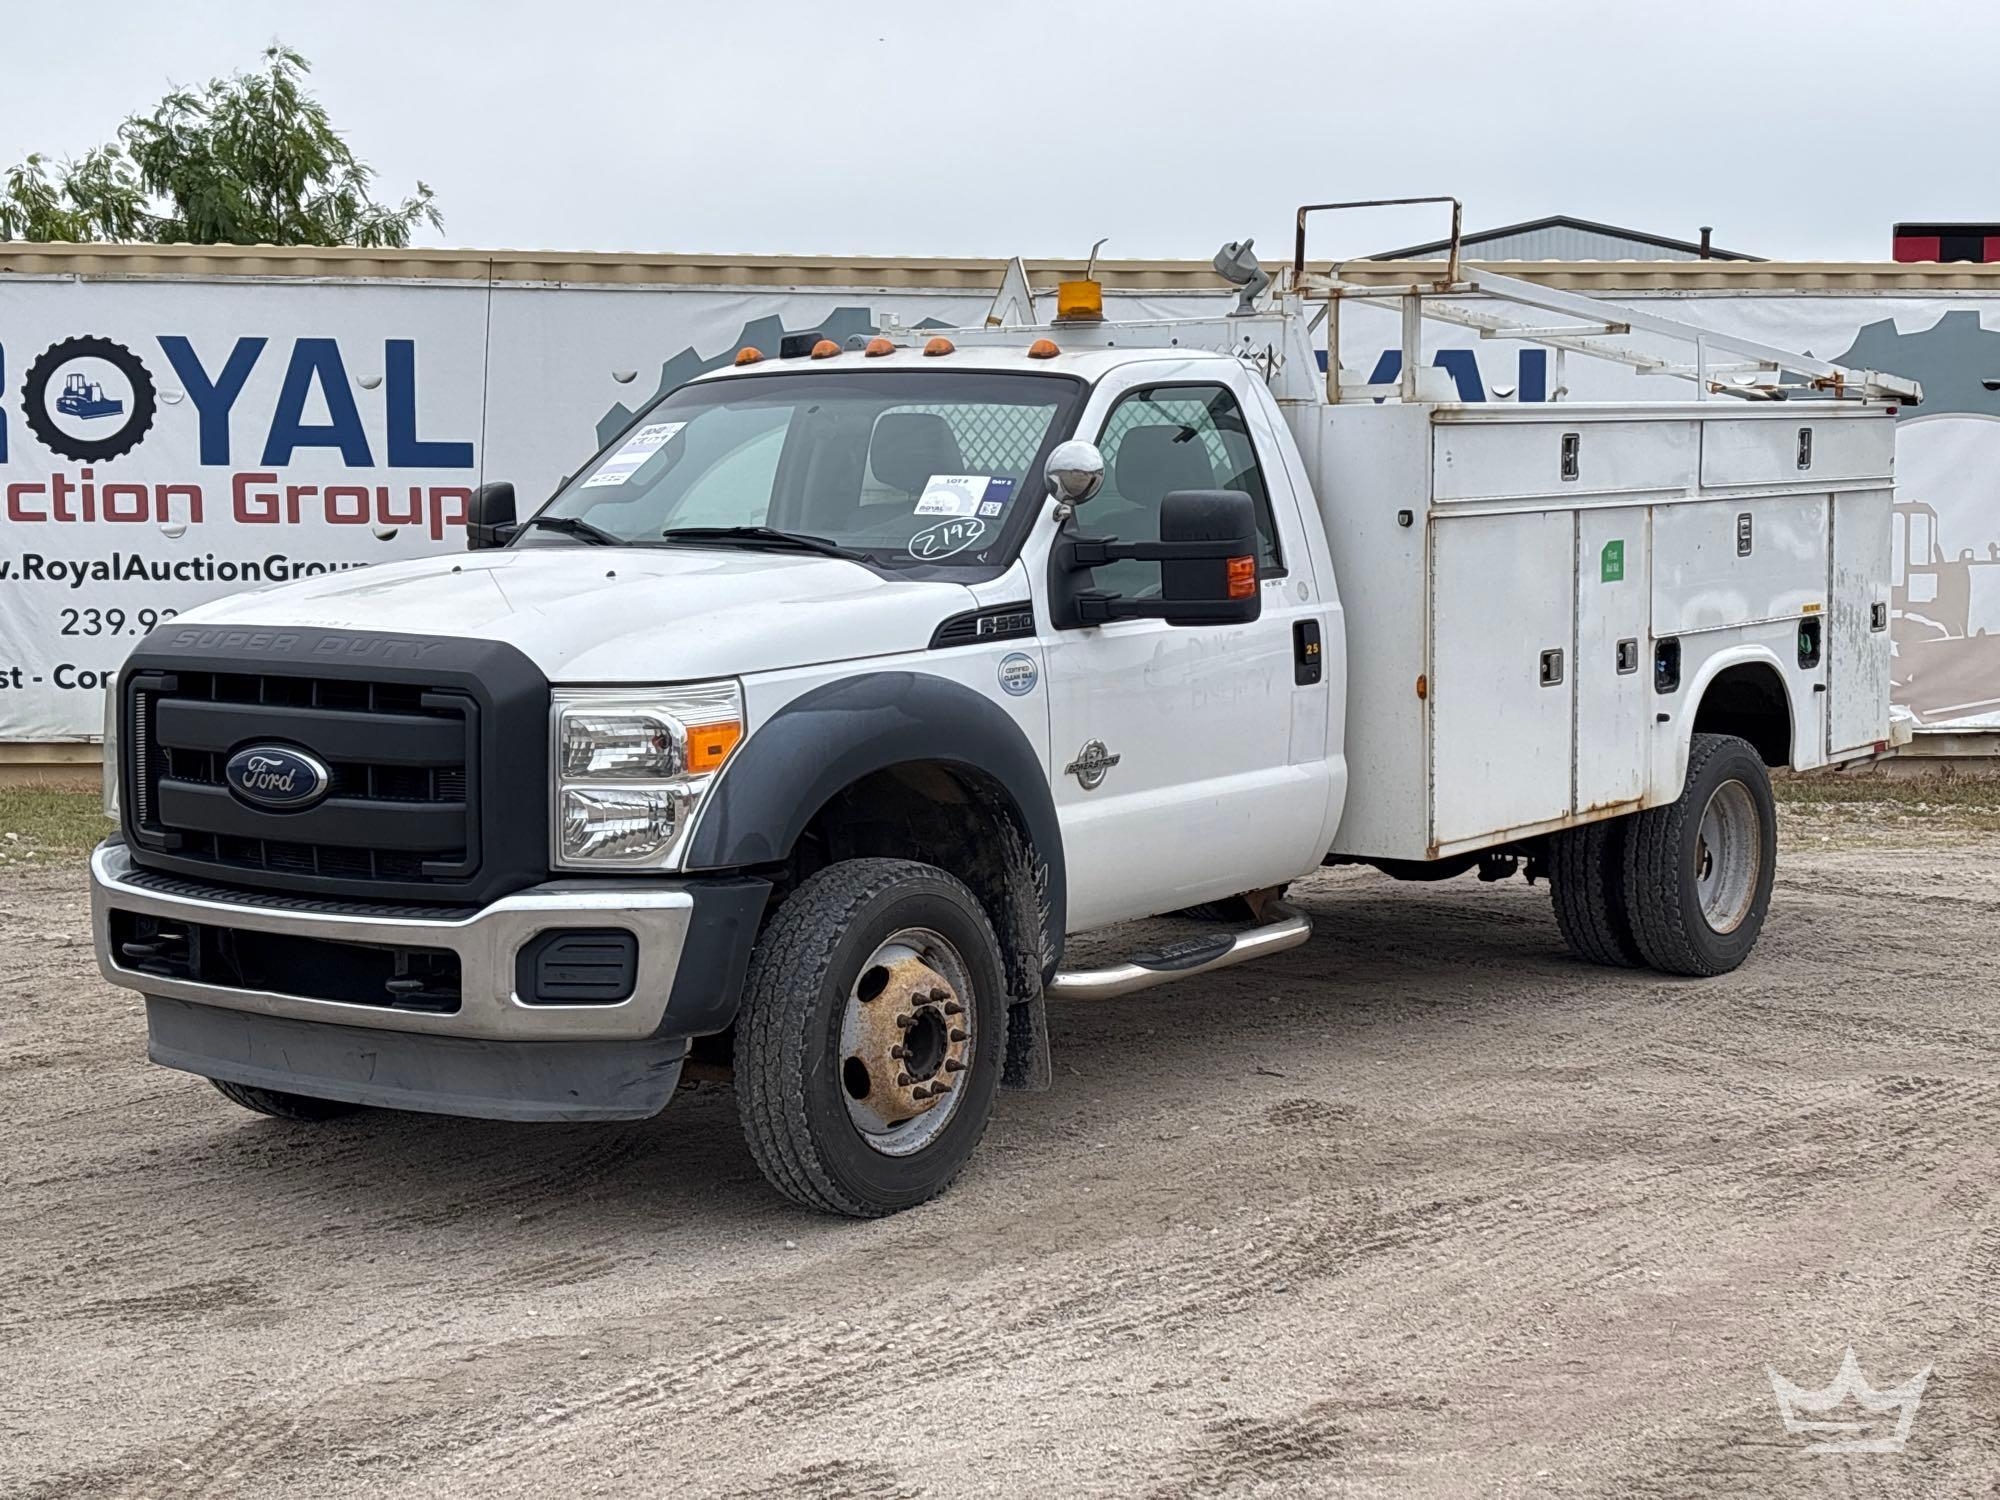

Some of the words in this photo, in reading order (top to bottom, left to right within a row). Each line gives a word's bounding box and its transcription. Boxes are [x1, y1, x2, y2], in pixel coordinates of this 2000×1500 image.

[0, 334, 474, 468] OYAL
[232, 472, 473, 540] Group
[915, 521, 981, 556] 2192
[171, 629, 302, 652] SUPER
[312, 635, 445, 660] DUTY
[1306, 643, 1319, 655] 25
[242, 756, 296, 792] Ford
